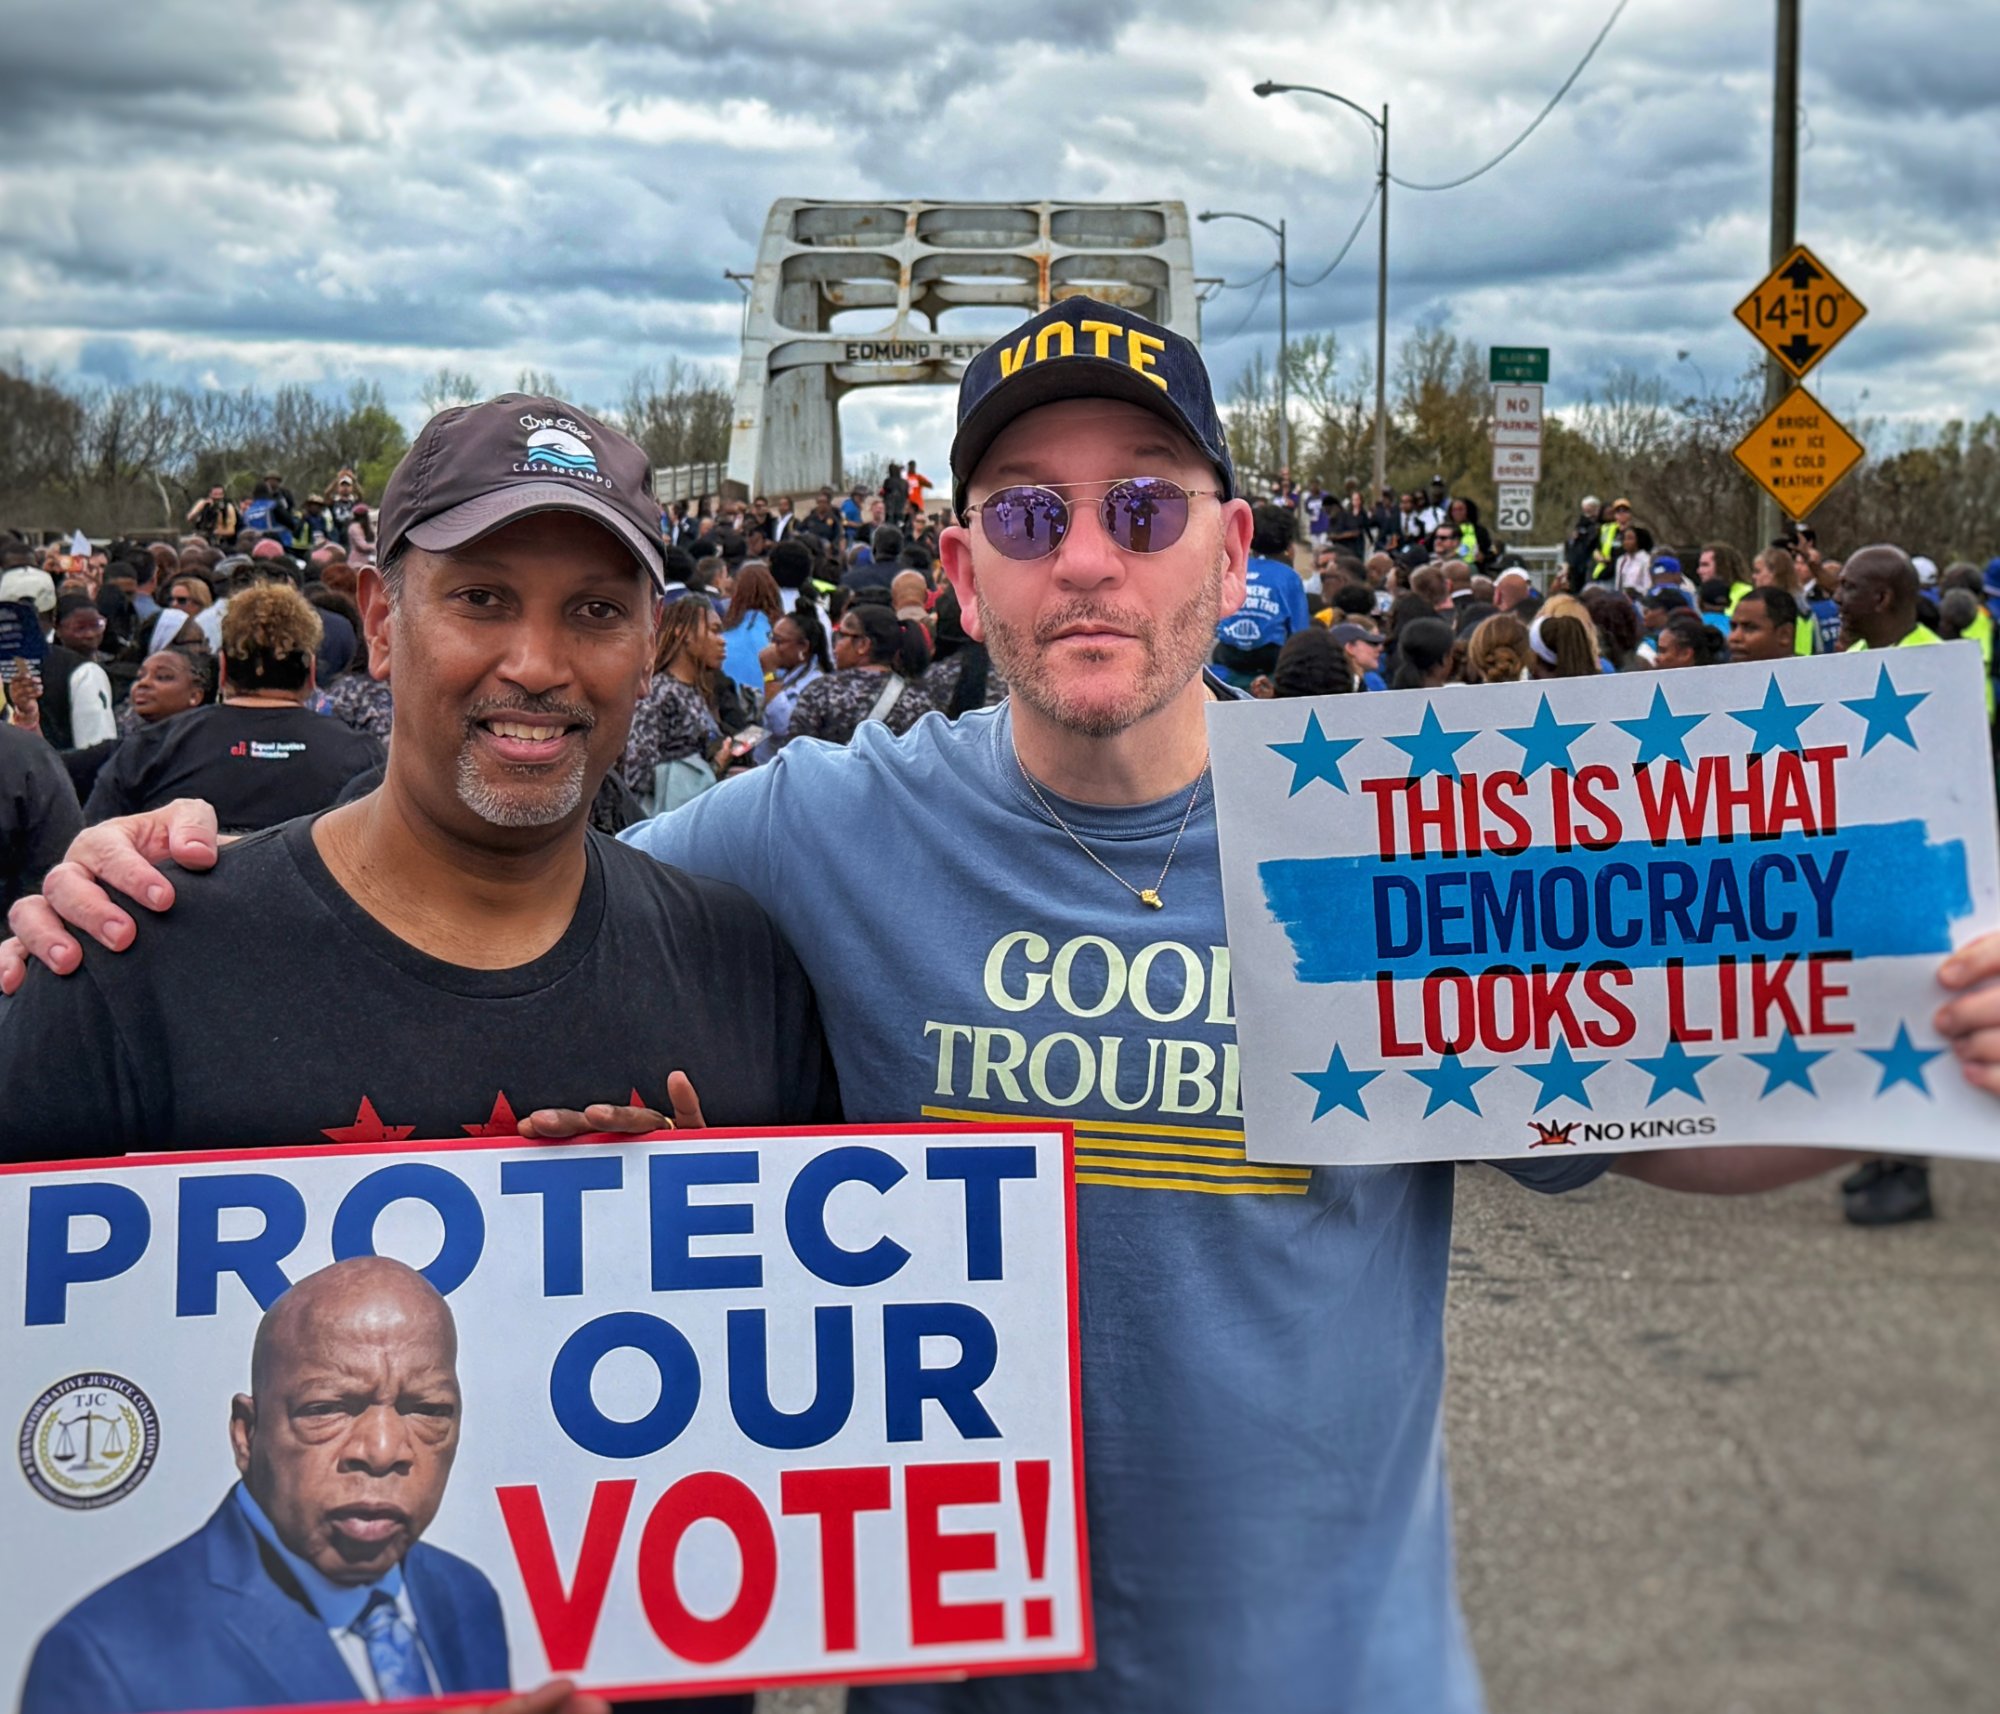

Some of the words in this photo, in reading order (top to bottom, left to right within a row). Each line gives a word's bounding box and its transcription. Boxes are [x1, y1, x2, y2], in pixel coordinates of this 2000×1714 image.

[845, 342, 930, 360] EDMUND
[1000, 319, 1168, 392] VOTE
[1505, 398, 1530, 414] NO
[1777, 416, 1819, 429] BRIDGE
[1771, 436, 1796, 448] MAY
[1807, 435, 1824, 448] ICE
[1770, 456, 1782, 468] IN
[1793, 454, 1826, 469] COLD
[513, 462, 548, 473] CASA
[567, 468, 613, 489] CAMPO
[1772, 474, 1825, 488] WEATHER
[1500, 508, 1532, 527] 20
[1361, 770, 1532, 863] THIS
[1551, 764, 1623, 853] IS
[1632, 745, 1849, 848] WHAT
[1372, 850, 1850, 960] DEMOCRACY
[1376, 960, 1637, 1058] LOOKS
[1665, 950, 1856, 1044] LIKE
[1584, 1123, 1625, 1142] NO
[1630, 1117, 1716, 1140] KINGS
[23, 1145, 1037, 1327] PROTECT
[549, 1301, 1002, 1459] OUR
[74, 1392, 108, 1408] TJC
[86, 1374, 135, 1398] JUSTICE
[131, 1393, 157, 1458] COALITION
[495, 1459, 1055, 1674] VOTE!
